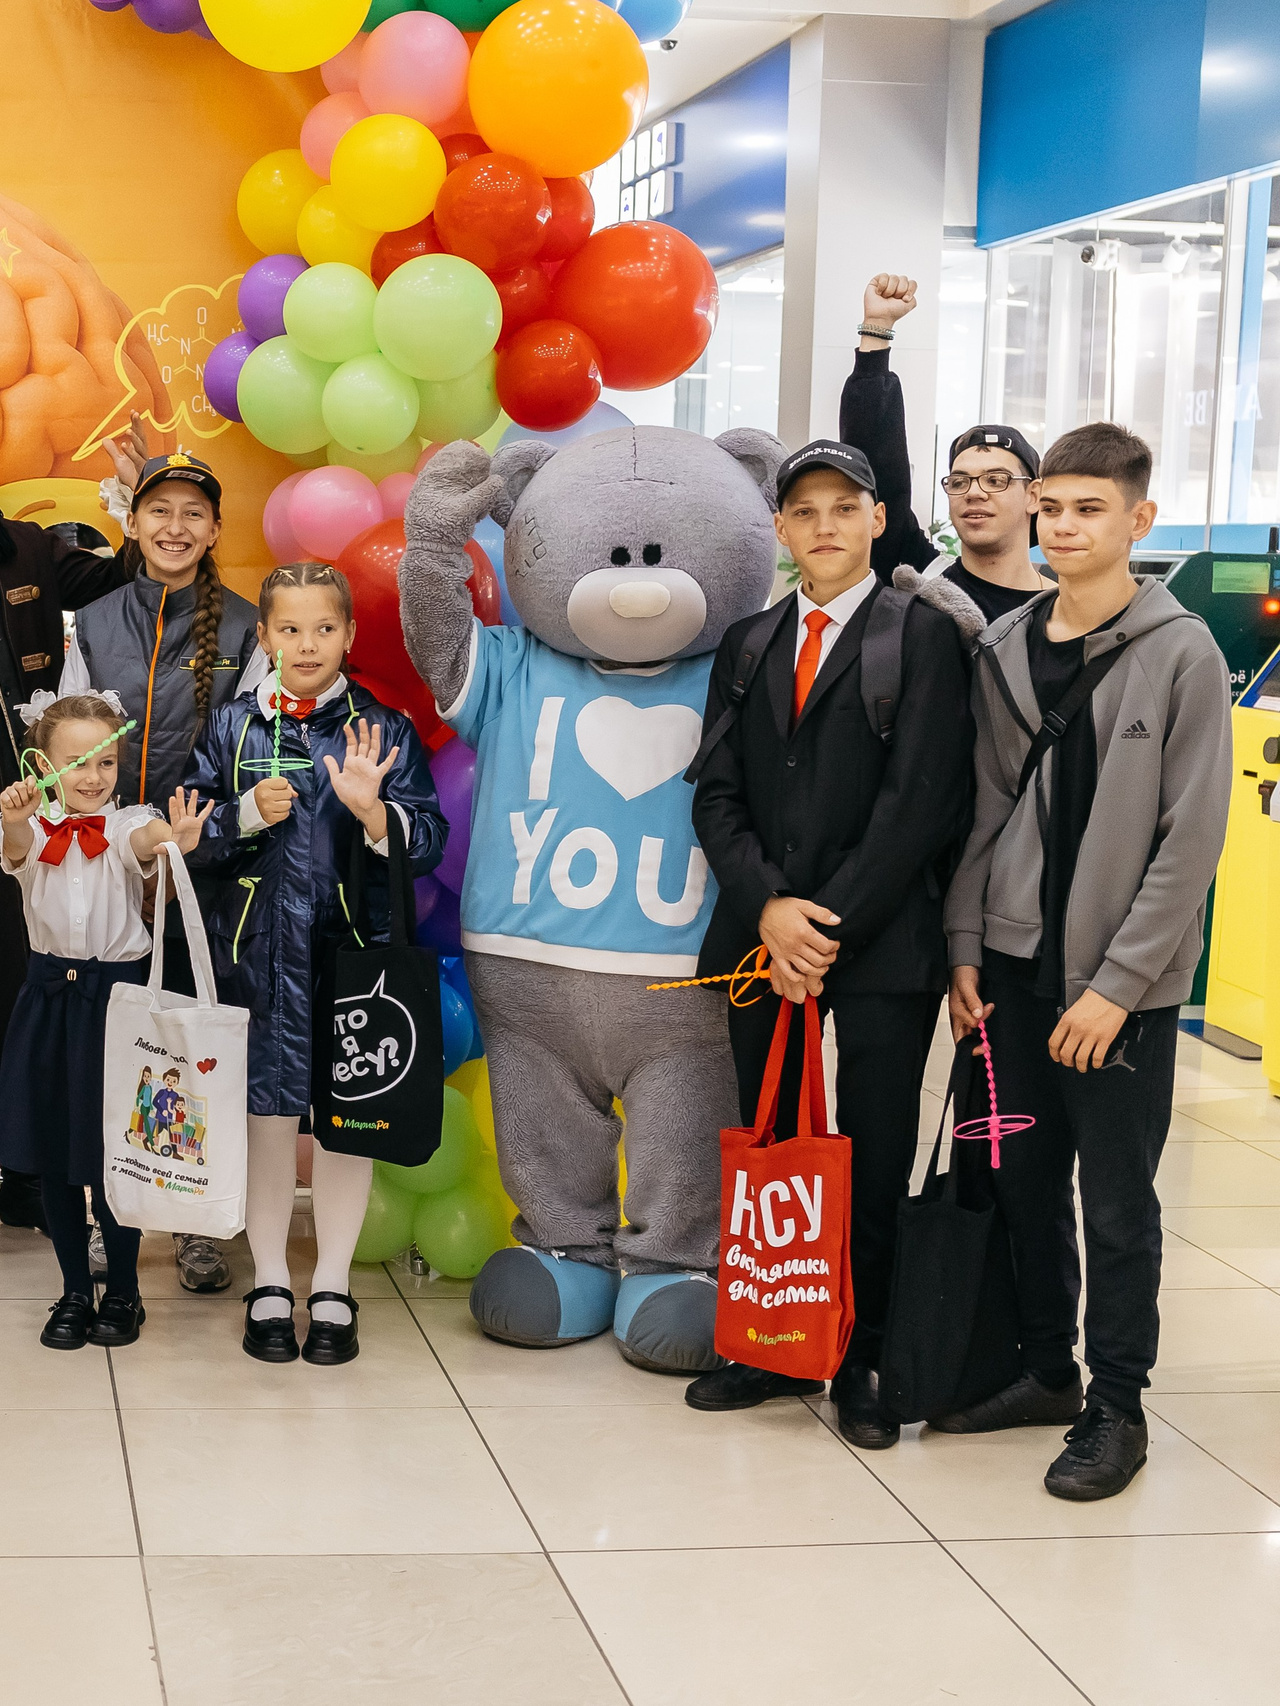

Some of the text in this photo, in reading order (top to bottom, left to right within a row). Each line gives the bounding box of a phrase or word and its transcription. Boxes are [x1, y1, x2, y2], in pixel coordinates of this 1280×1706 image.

[1121, 731, 1151, 739] adidas
[528, 696, 566, 801] I
[134, 1036, 168, 1056] Любовь
[152, 1167, 173, 1179] всей
[174, 1173, 209, 1186] семьёй
[761, 1285, 831, 1309] семьи
